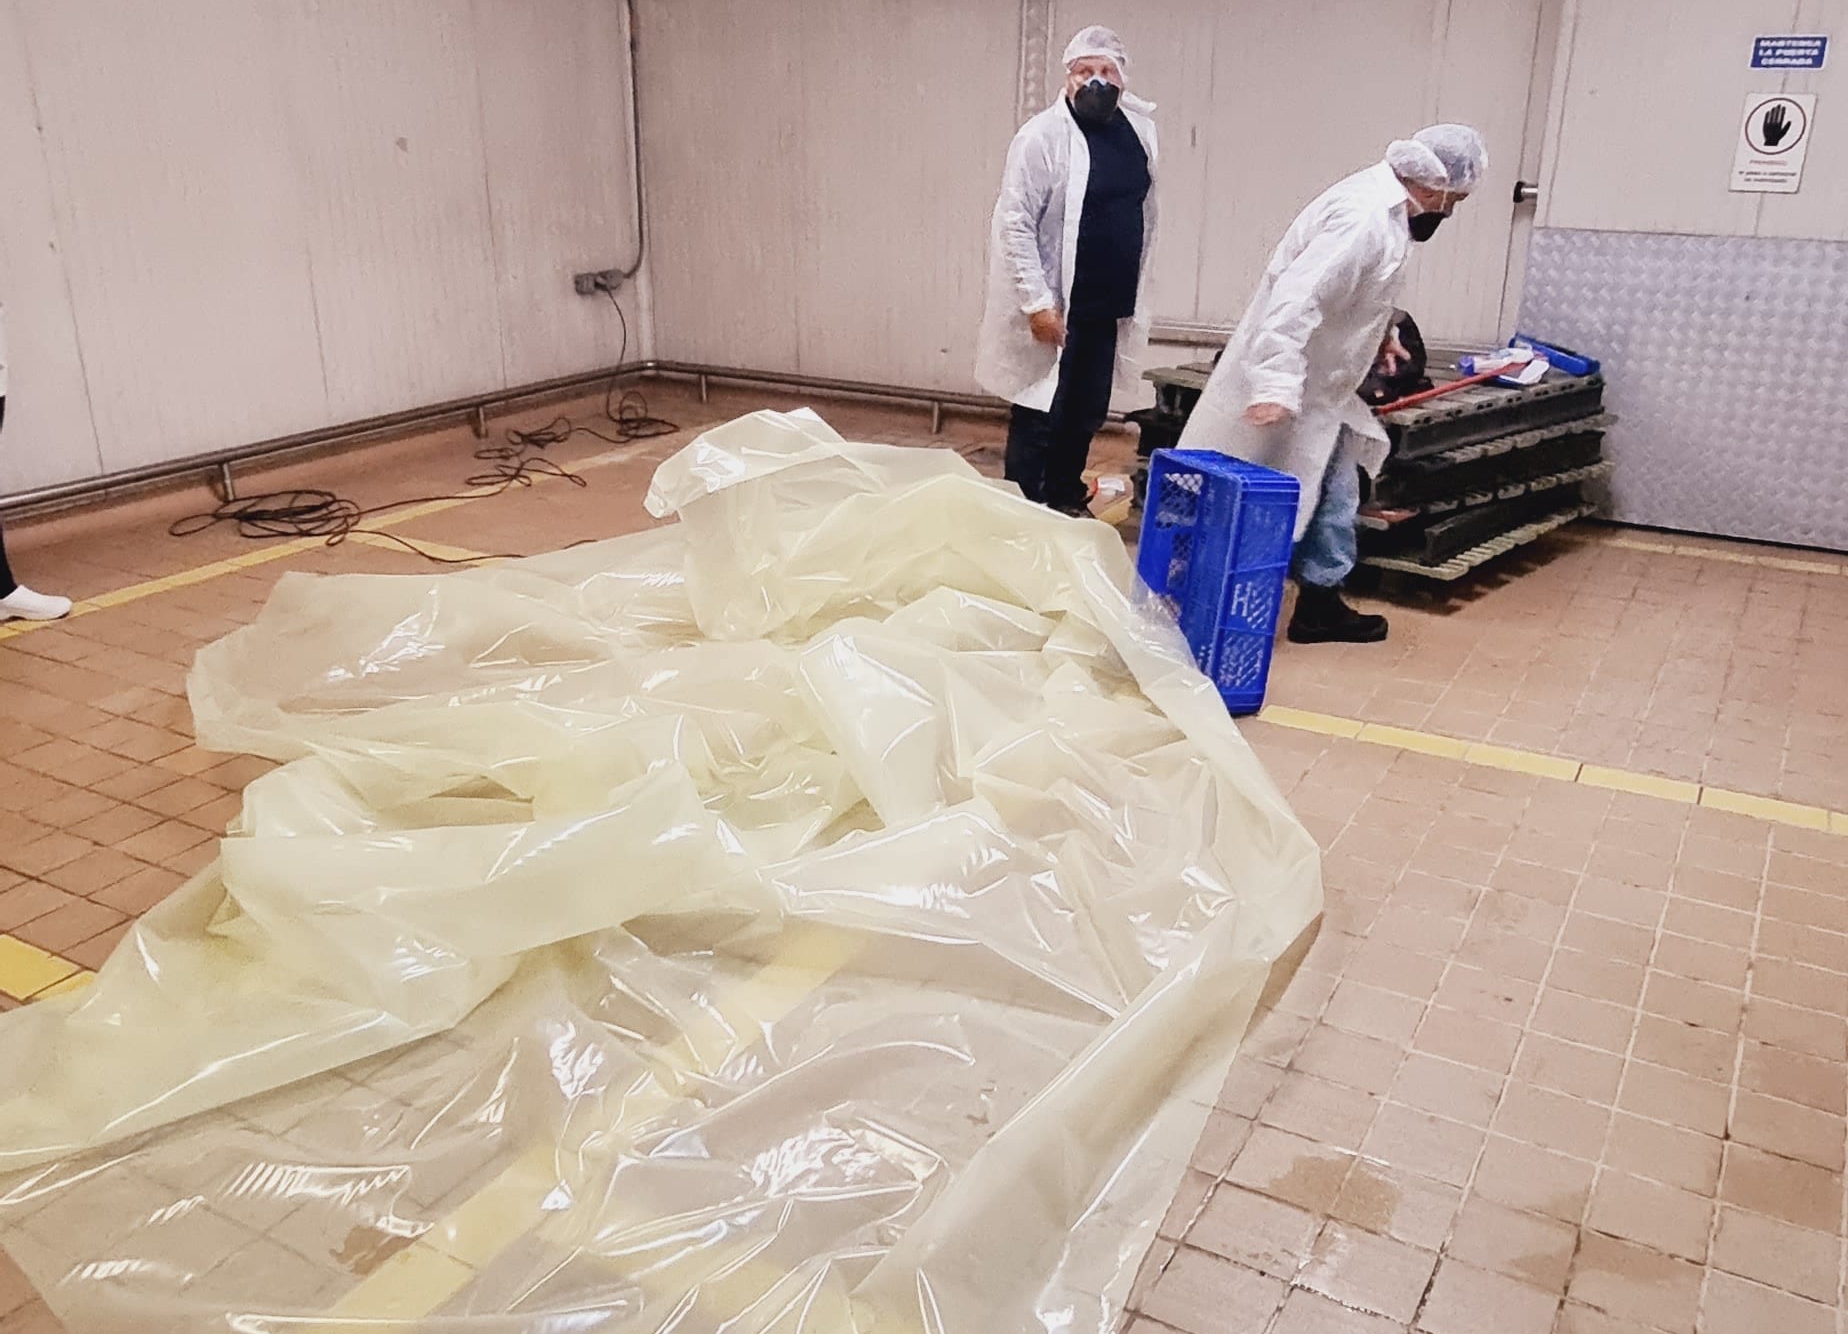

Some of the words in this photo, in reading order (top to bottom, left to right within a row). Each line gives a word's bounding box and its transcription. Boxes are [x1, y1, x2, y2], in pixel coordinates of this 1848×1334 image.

[1758, 48, 1773, 56] LA
[1775, 48, 1819, 56] PUERTA
[1760, 57, 1813, 65] CERRADA
